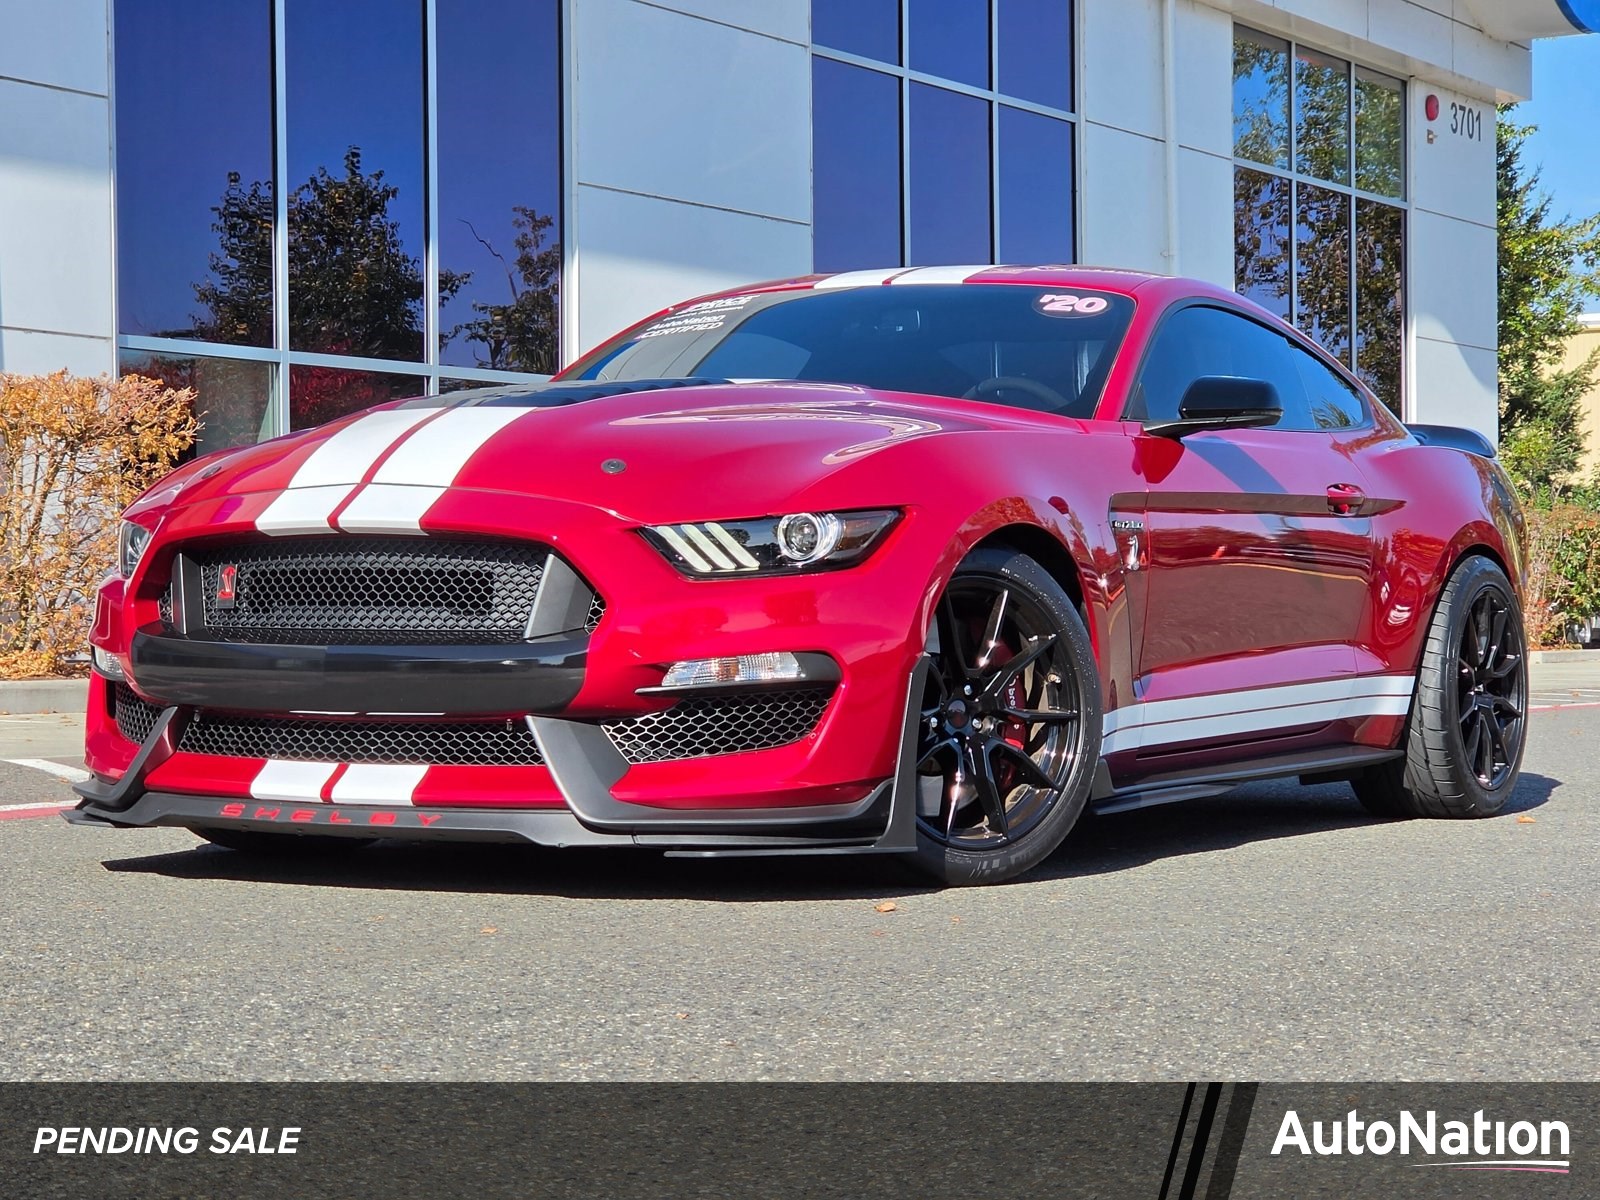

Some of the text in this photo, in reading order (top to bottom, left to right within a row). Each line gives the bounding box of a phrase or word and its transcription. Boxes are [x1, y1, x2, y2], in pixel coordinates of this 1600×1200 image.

[1450, 102, 1481, 142] 3701
[646, 315, 726, 332] AutoNation
[219, 802, 443, 828] SHELBY
